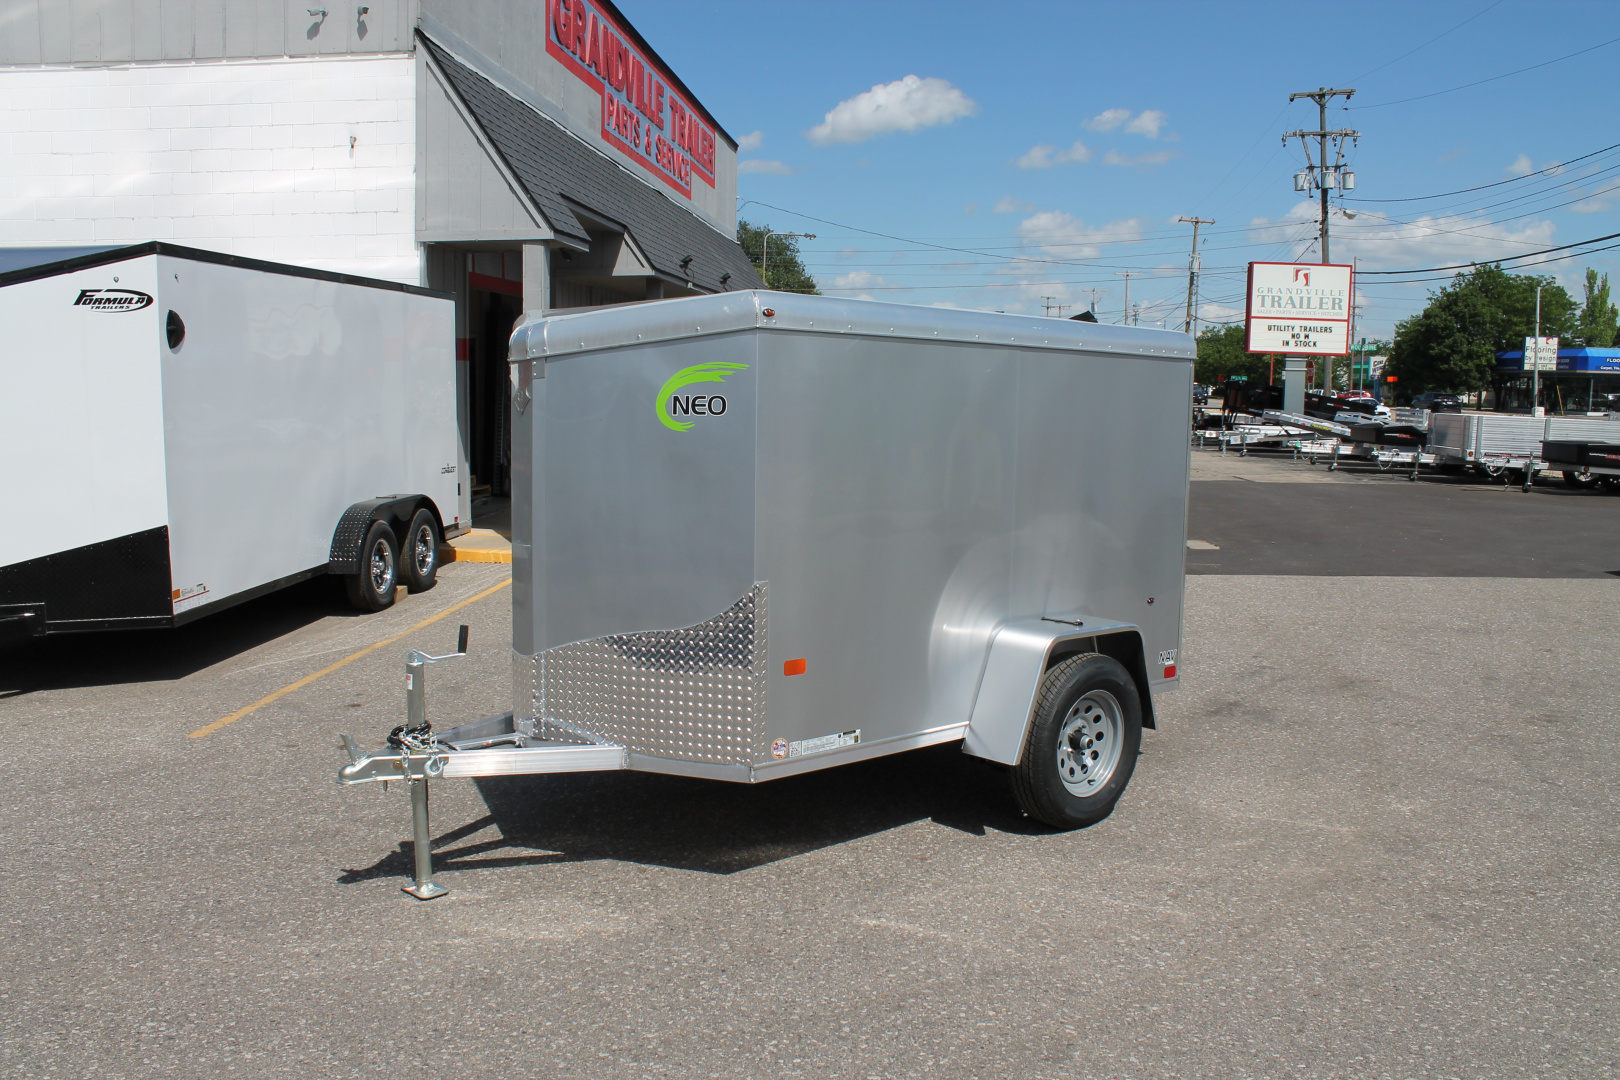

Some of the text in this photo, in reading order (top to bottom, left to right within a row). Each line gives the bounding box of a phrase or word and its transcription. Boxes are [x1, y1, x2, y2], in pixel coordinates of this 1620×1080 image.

[552, 0, 714, 175] GRANDVILLE TRAILER
[606, 91, 690, 186] PARTS & SERVICE
[73, 288, 147, 306] FORMULA
[1257, 286, 1345, 297] GRANDVILLE
[1257, 294, 1343, 311] TRAILER
[1267, 324, 1333, 334] UTILITY TRAILERS
[1294, 340, 1318, 348] STOCK
[1525, 345, 1557, 356] Flooring
[672, 395, 728, 416] NEO
